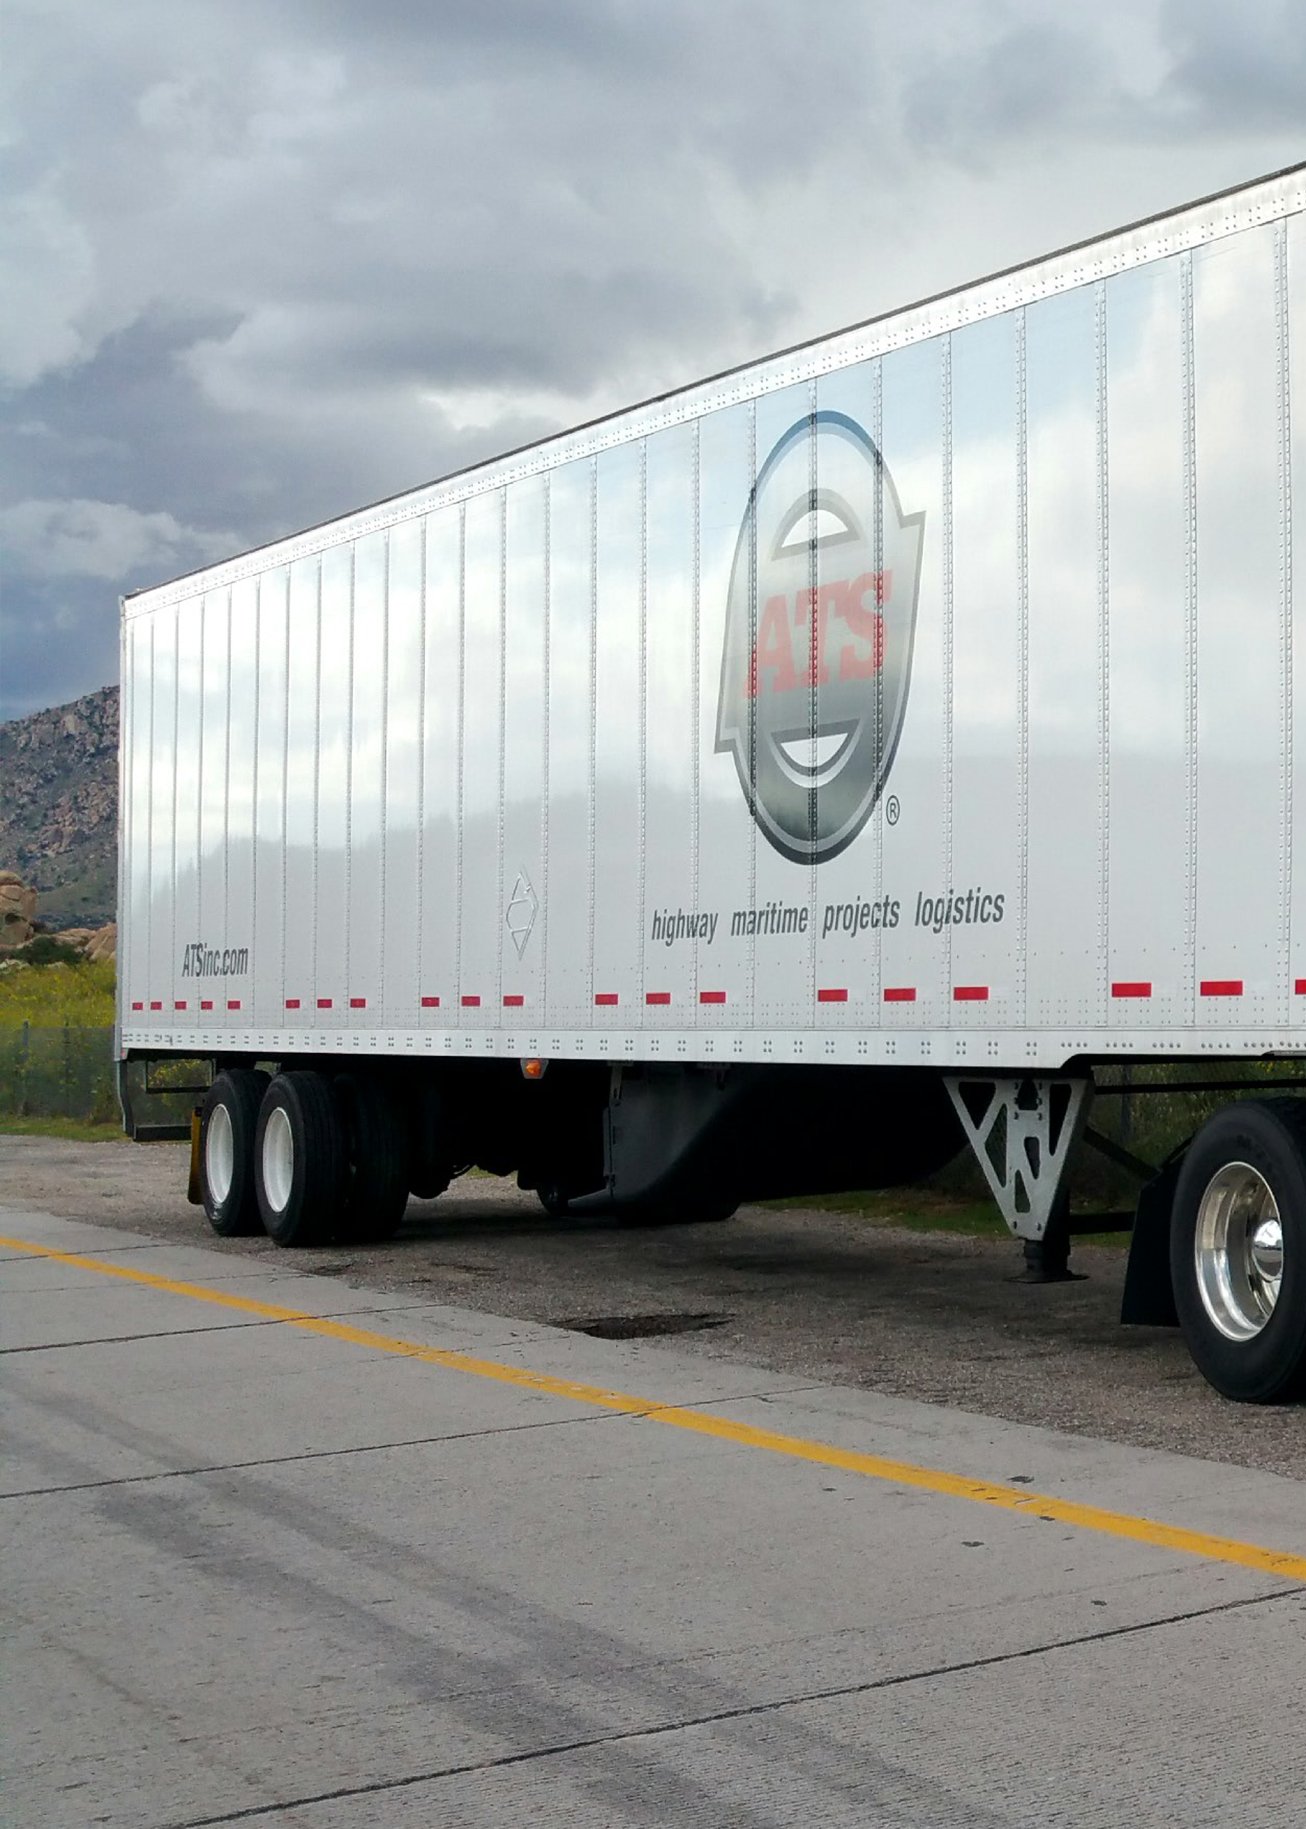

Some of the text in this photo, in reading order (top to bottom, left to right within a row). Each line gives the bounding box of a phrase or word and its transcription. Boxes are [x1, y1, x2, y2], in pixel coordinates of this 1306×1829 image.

[742, 569, 893, 700] ATS
[651, 886, 1006, 947] highway maritime projects logistics
[181, 942, 249, 978] ATSinc.com
